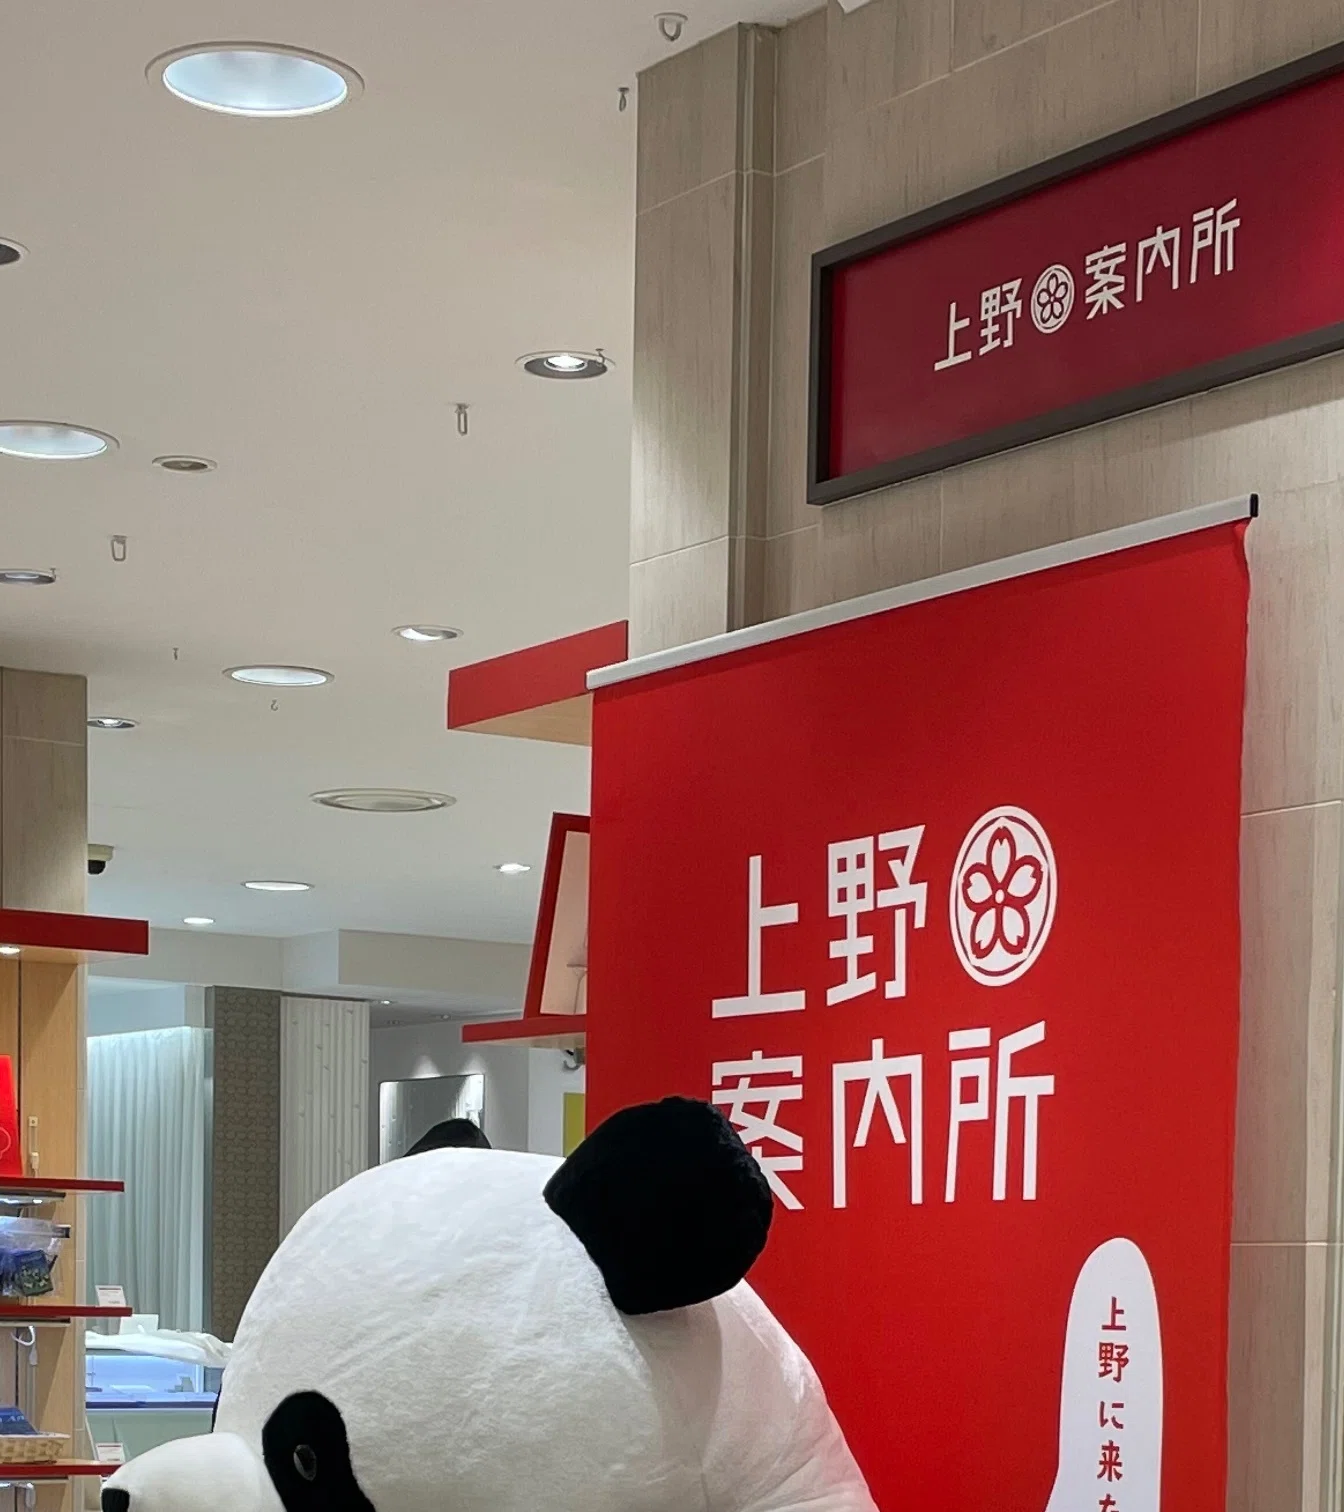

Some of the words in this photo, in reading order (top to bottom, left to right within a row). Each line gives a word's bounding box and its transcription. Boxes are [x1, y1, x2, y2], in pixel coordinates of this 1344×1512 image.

[711, 825, 927, 1018] 上野
[711, 1021, 1055, 1210] 案内所
